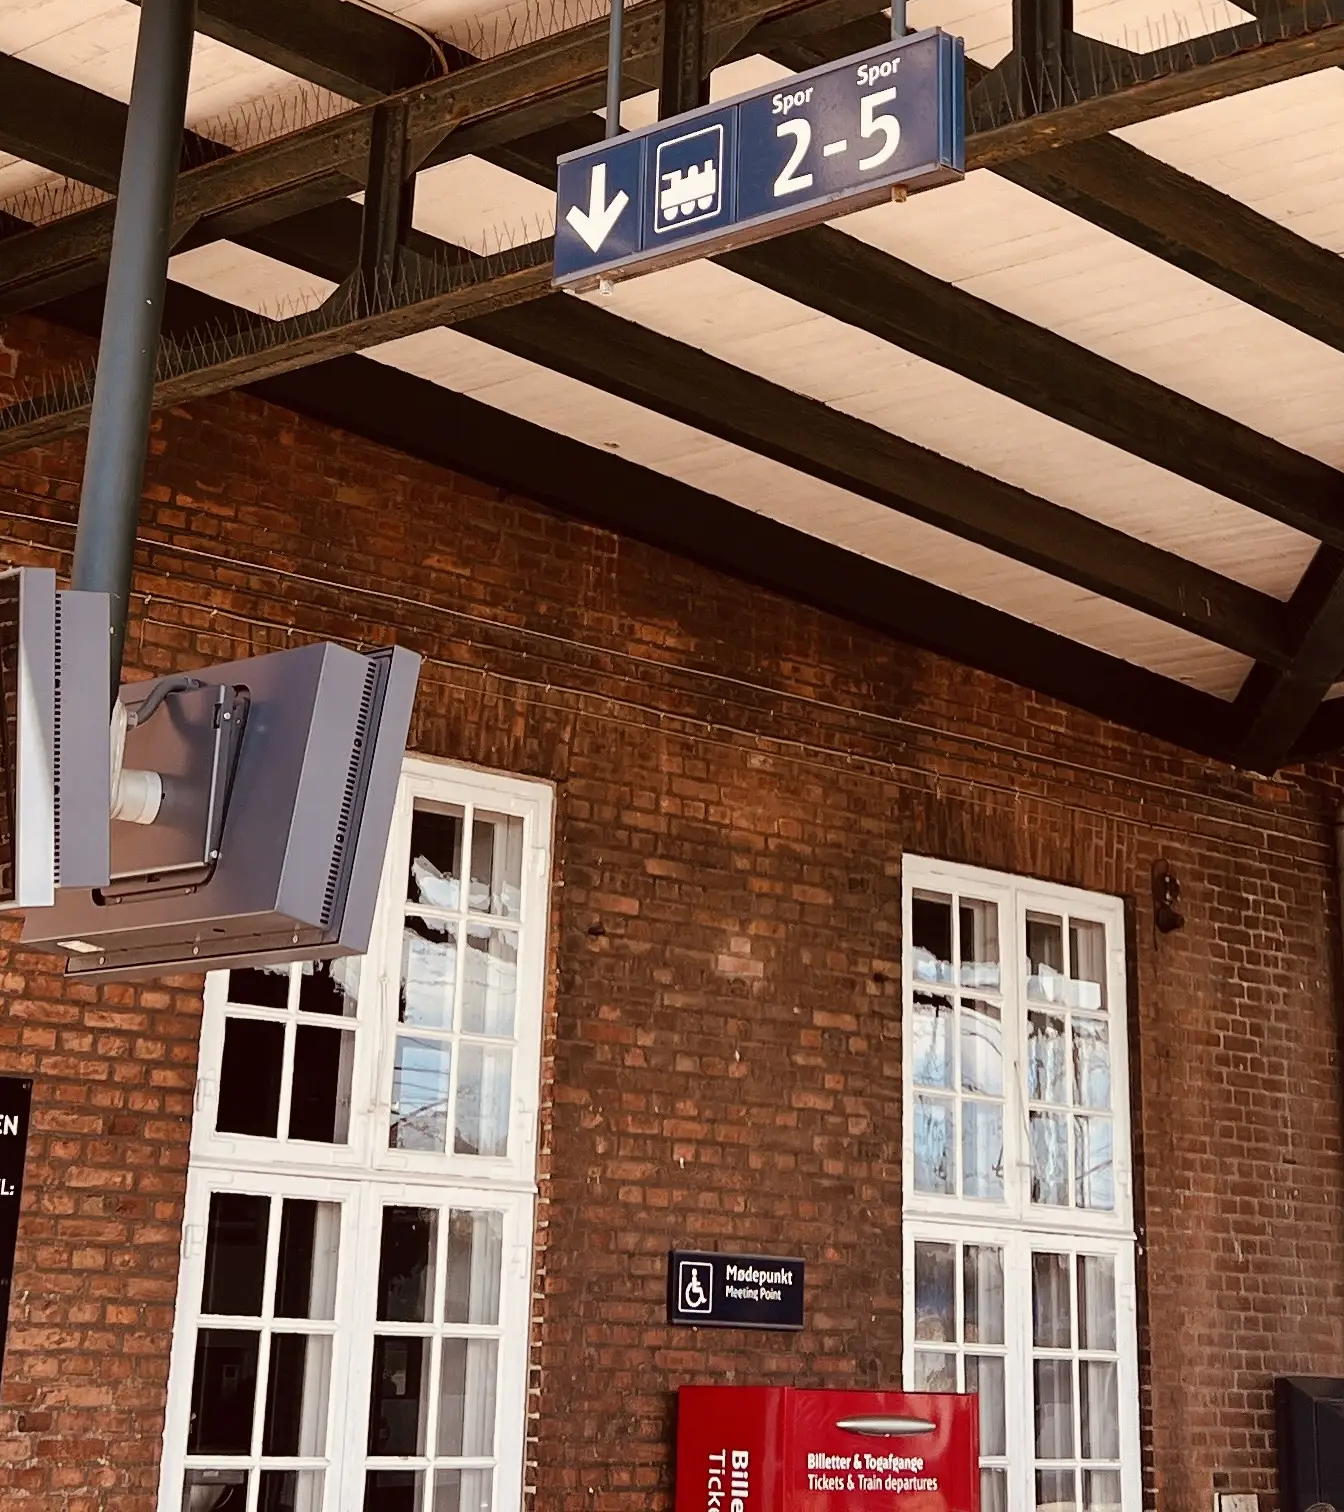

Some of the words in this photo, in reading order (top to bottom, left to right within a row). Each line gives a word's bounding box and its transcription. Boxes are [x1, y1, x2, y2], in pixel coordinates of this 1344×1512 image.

[772, 87, 814, 115] Spor
[856, 57, 901, 86] Spor
[726, 1264, 793, 1286] Mødepunkt
[725, 1285, 759, 1302] Meeting
[759, 1287, 782, 1301] Point
[807, 1452, 852, 1470] Billetter
[853, 1453, 863, 1470] &
[863, 1453, 924, 1473] Togafgange
[807, 1473, 845, 1491] Tickets
[846, 1473, 855, 1491] &
[857, 1474, 883, 1491] Train
[884, 1474, 938, 1493] departures
